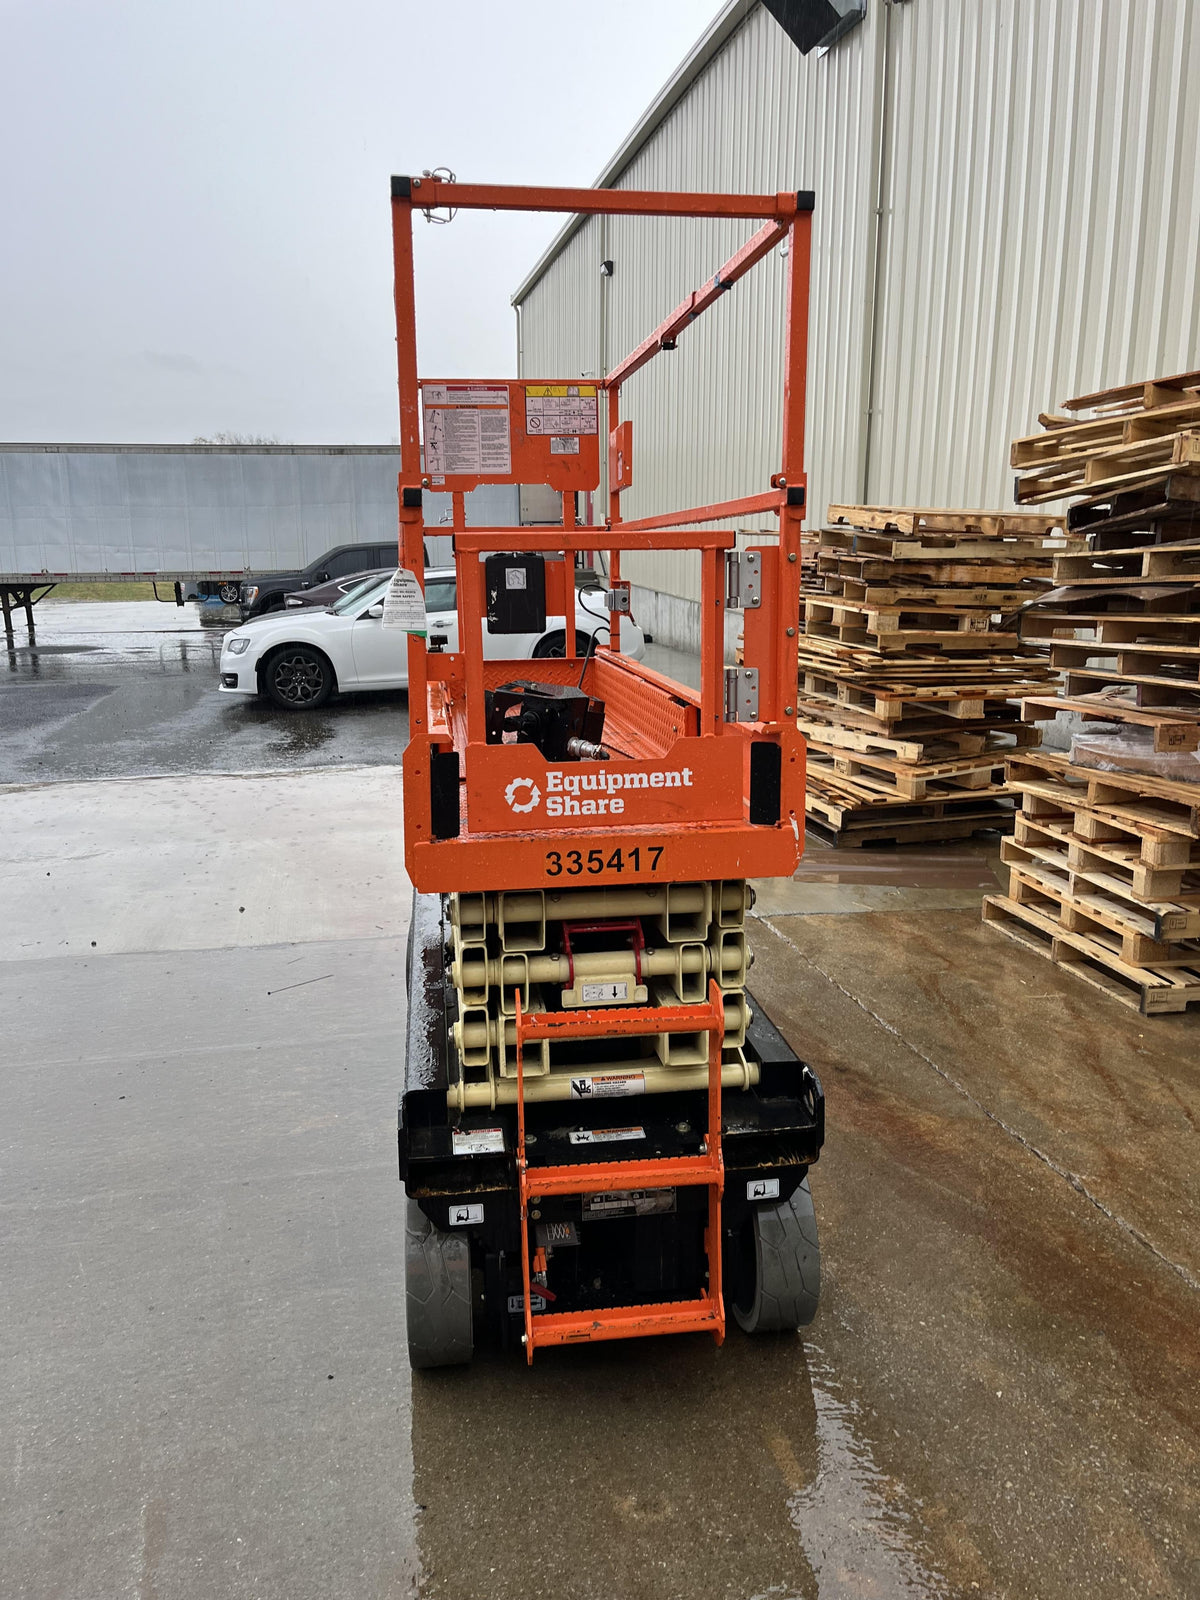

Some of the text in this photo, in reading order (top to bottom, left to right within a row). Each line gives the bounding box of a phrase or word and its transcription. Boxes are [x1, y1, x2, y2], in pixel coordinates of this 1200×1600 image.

[546, 768, 693, 796] Equipment
[546, 796, 624, 817] Share
[545, 847, 664, 876] 335417
